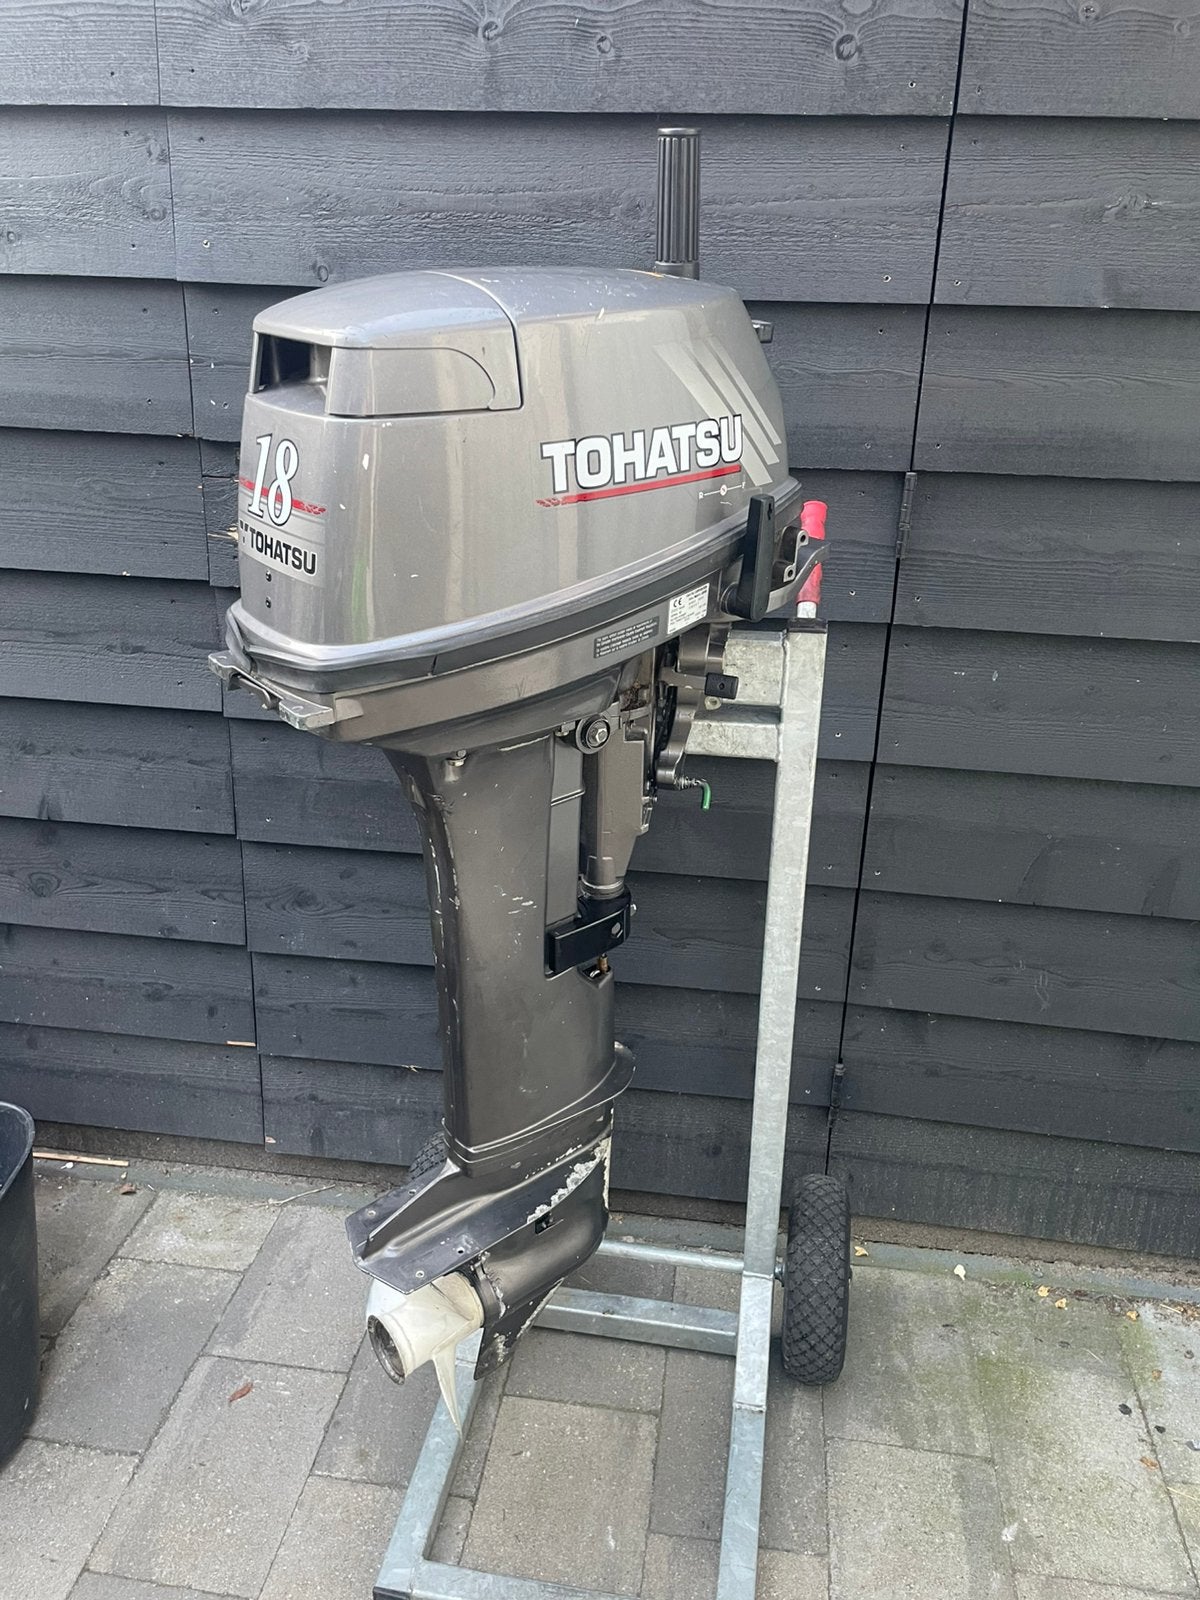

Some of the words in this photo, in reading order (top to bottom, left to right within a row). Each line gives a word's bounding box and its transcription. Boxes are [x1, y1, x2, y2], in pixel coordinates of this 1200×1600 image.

[247, 433, 299, 527] 18
[539, 413, 744, 494] TOHATSU
[249, 529, 317, 575] TOHATSU
